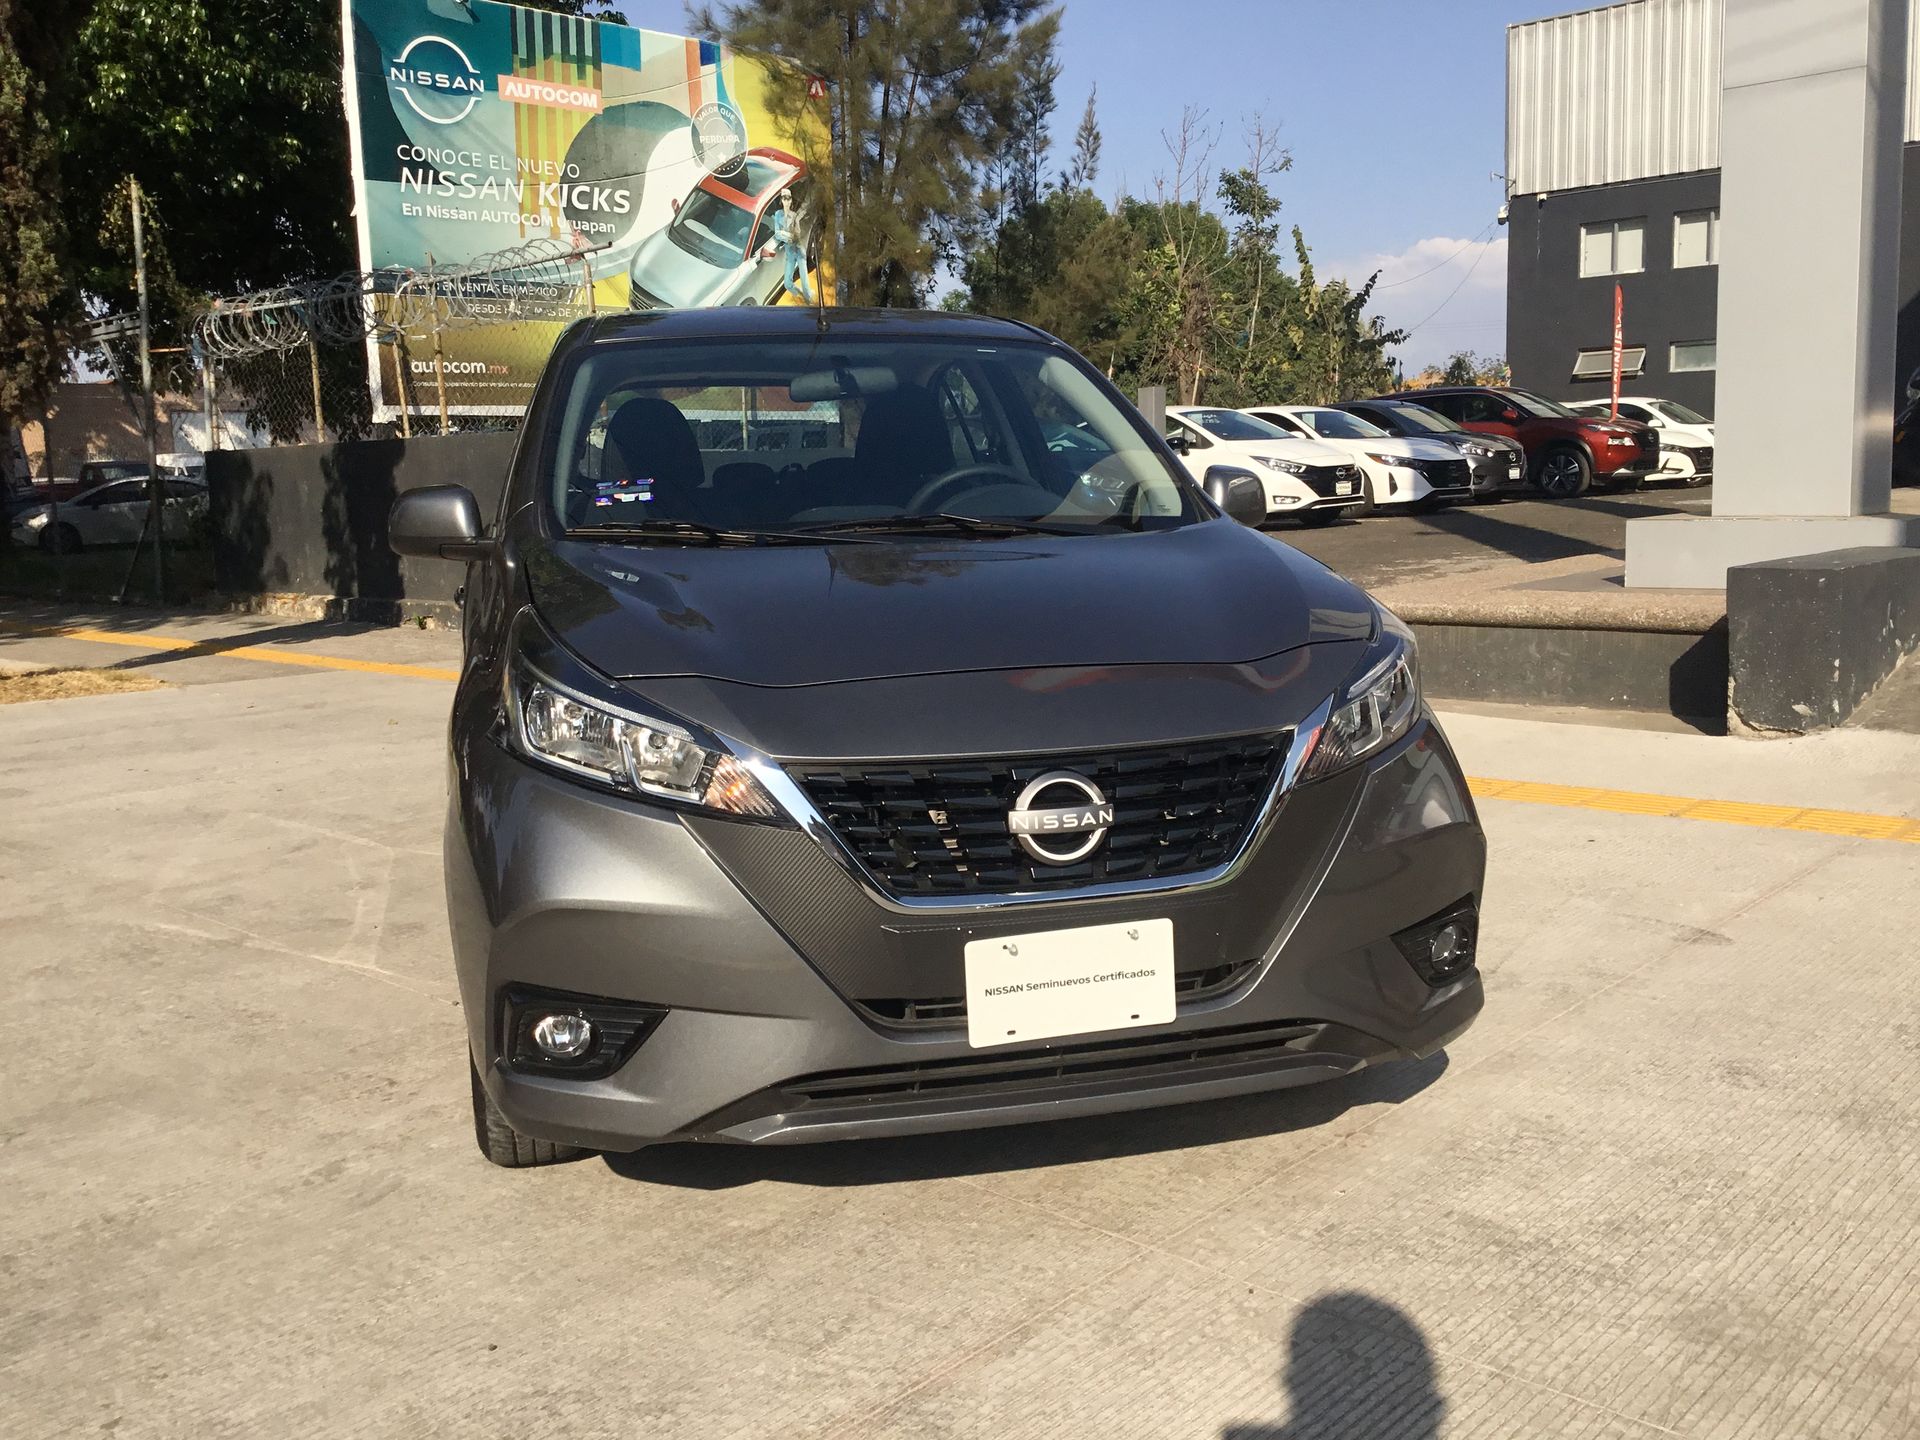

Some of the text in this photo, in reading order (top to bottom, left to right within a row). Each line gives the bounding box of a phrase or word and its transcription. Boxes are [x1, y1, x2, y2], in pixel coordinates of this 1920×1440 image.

[390, 66, 485, 93] NISSAN
[504, 82, 598, 109] AUTOCOM
[396, 144, 581, 179] CONOCE EL NUEVO
[400, 166, 631, 215] NISSAN KICKS
[401, 203, 422, 217] En
[426, 205, 478, 222] Nissan
[480, 210, 554, 228] AUTOCOM
[467, 303, 501, 314] DESDE
[558, 308, 572, 318] DE
[410, 359, 509, 375] autocom.mx
[1012, 808, 1113, 830] NISSAN
[984, 969, 1156, 997] NISSAN Seminuevos Certificados
